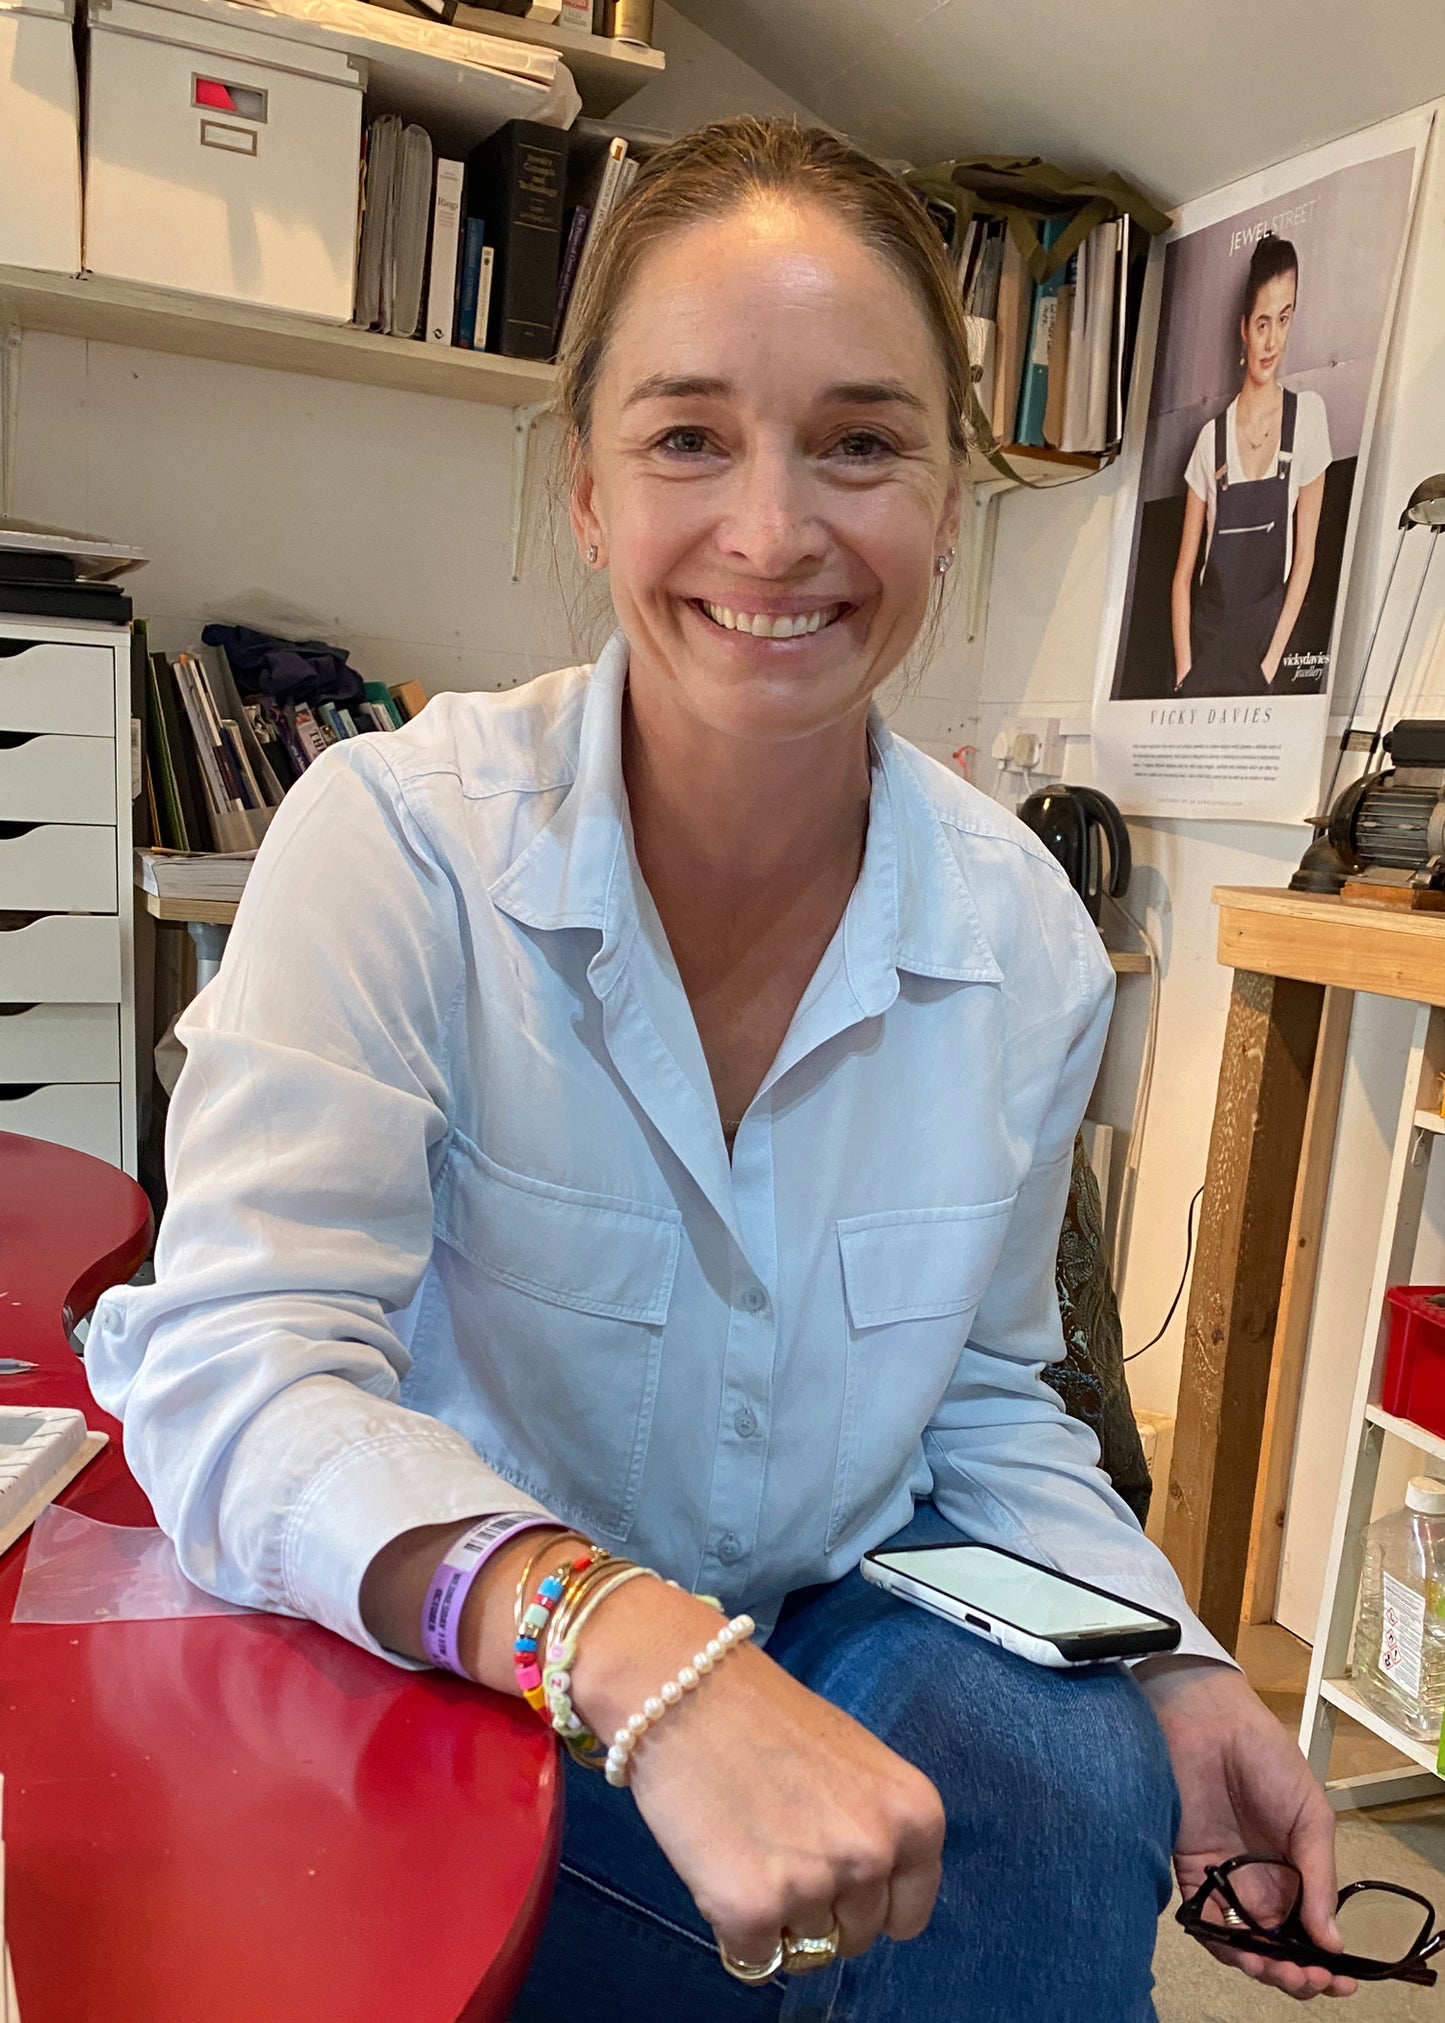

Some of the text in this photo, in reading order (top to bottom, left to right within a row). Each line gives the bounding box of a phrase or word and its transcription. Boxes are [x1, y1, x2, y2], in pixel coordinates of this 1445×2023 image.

[1283, 651, 1330, 669] vickydavies
[1150, 707, 1273, 725] VICKY DAVIES
